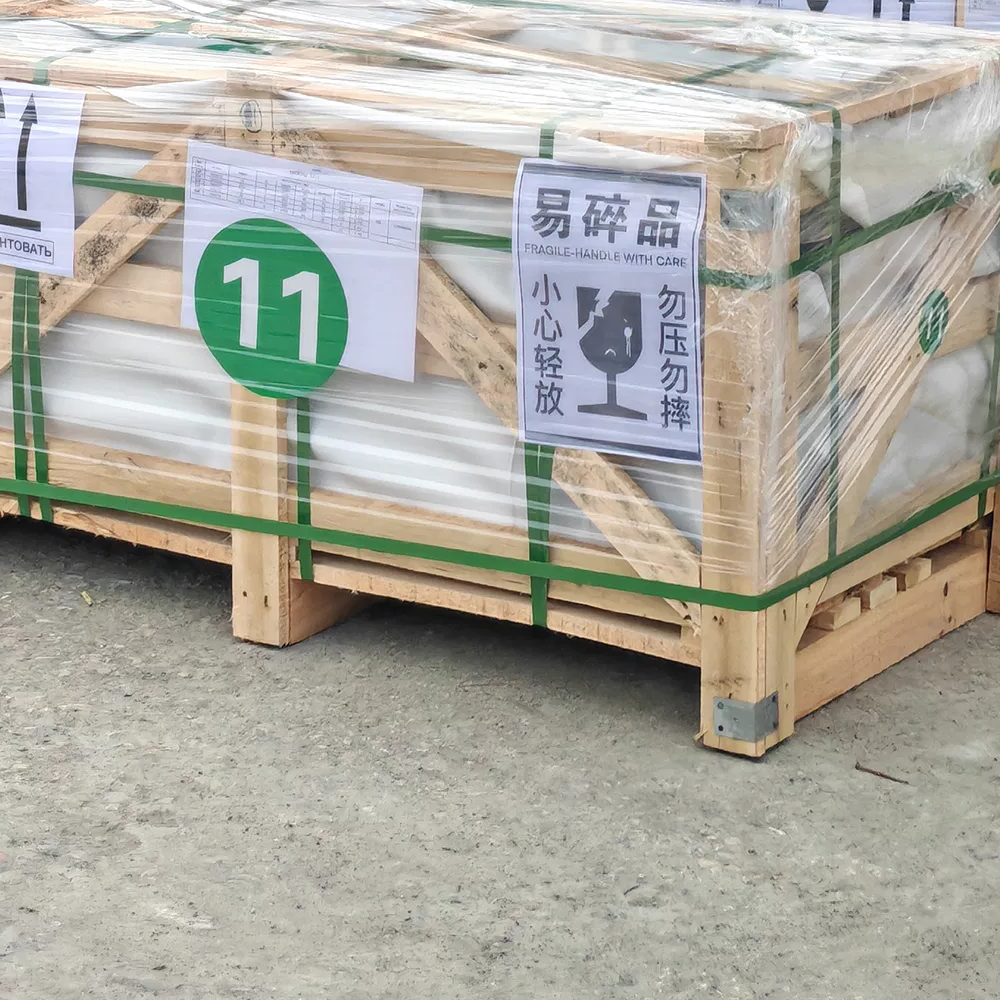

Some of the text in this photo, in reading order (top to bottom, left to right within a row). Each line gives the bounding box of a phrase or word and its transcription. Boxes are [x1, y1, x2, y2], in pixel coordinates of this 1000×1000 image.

[524, 243, 688, 268] FRAGILE-HANDLE WITH CARE
[531, 187, 681, 248] 易碎品
[223, 257, 320, 364] 11
[531, 273, 564, 416] 小心轻放
[657, 284, 691, 432] 勿压勿摔
